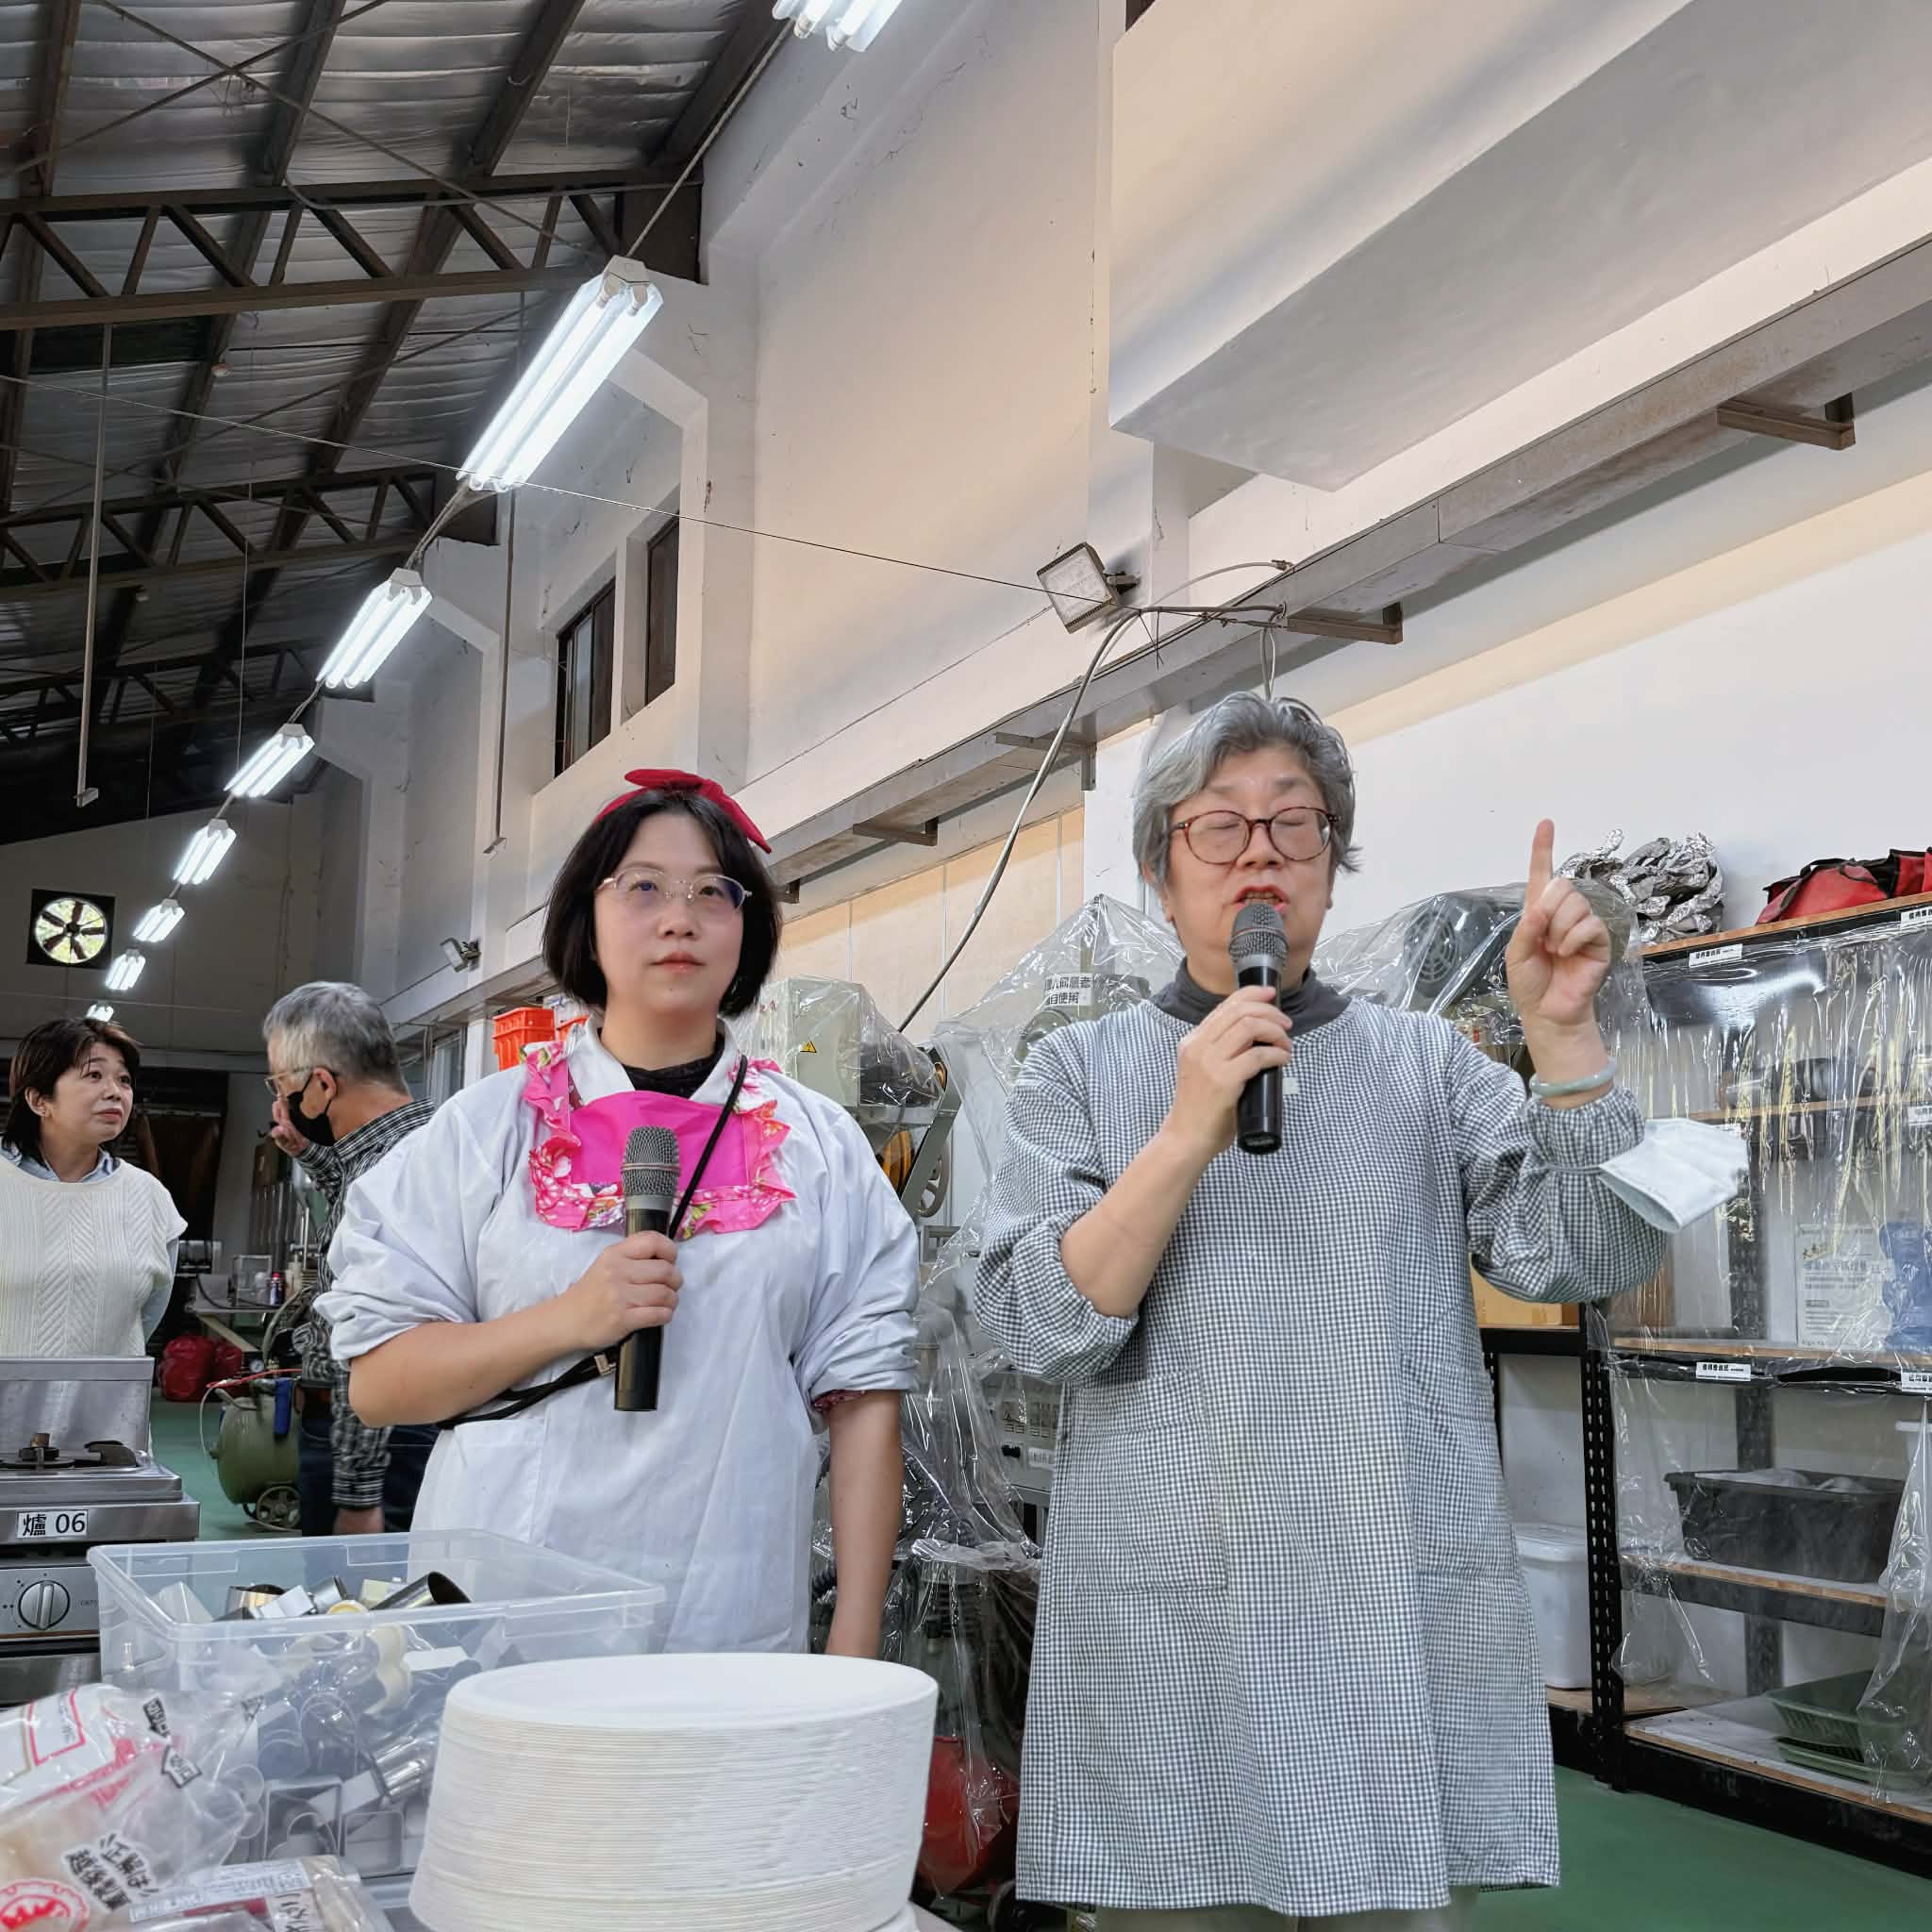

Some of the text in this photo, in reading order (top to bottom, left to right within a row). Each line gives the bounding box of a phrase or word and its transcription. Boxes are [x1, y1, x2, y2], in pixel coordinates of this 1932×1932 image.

[1046, 991, 1079, 1005] 自使用
[23, 1512, 86, 1536] 爐 06
